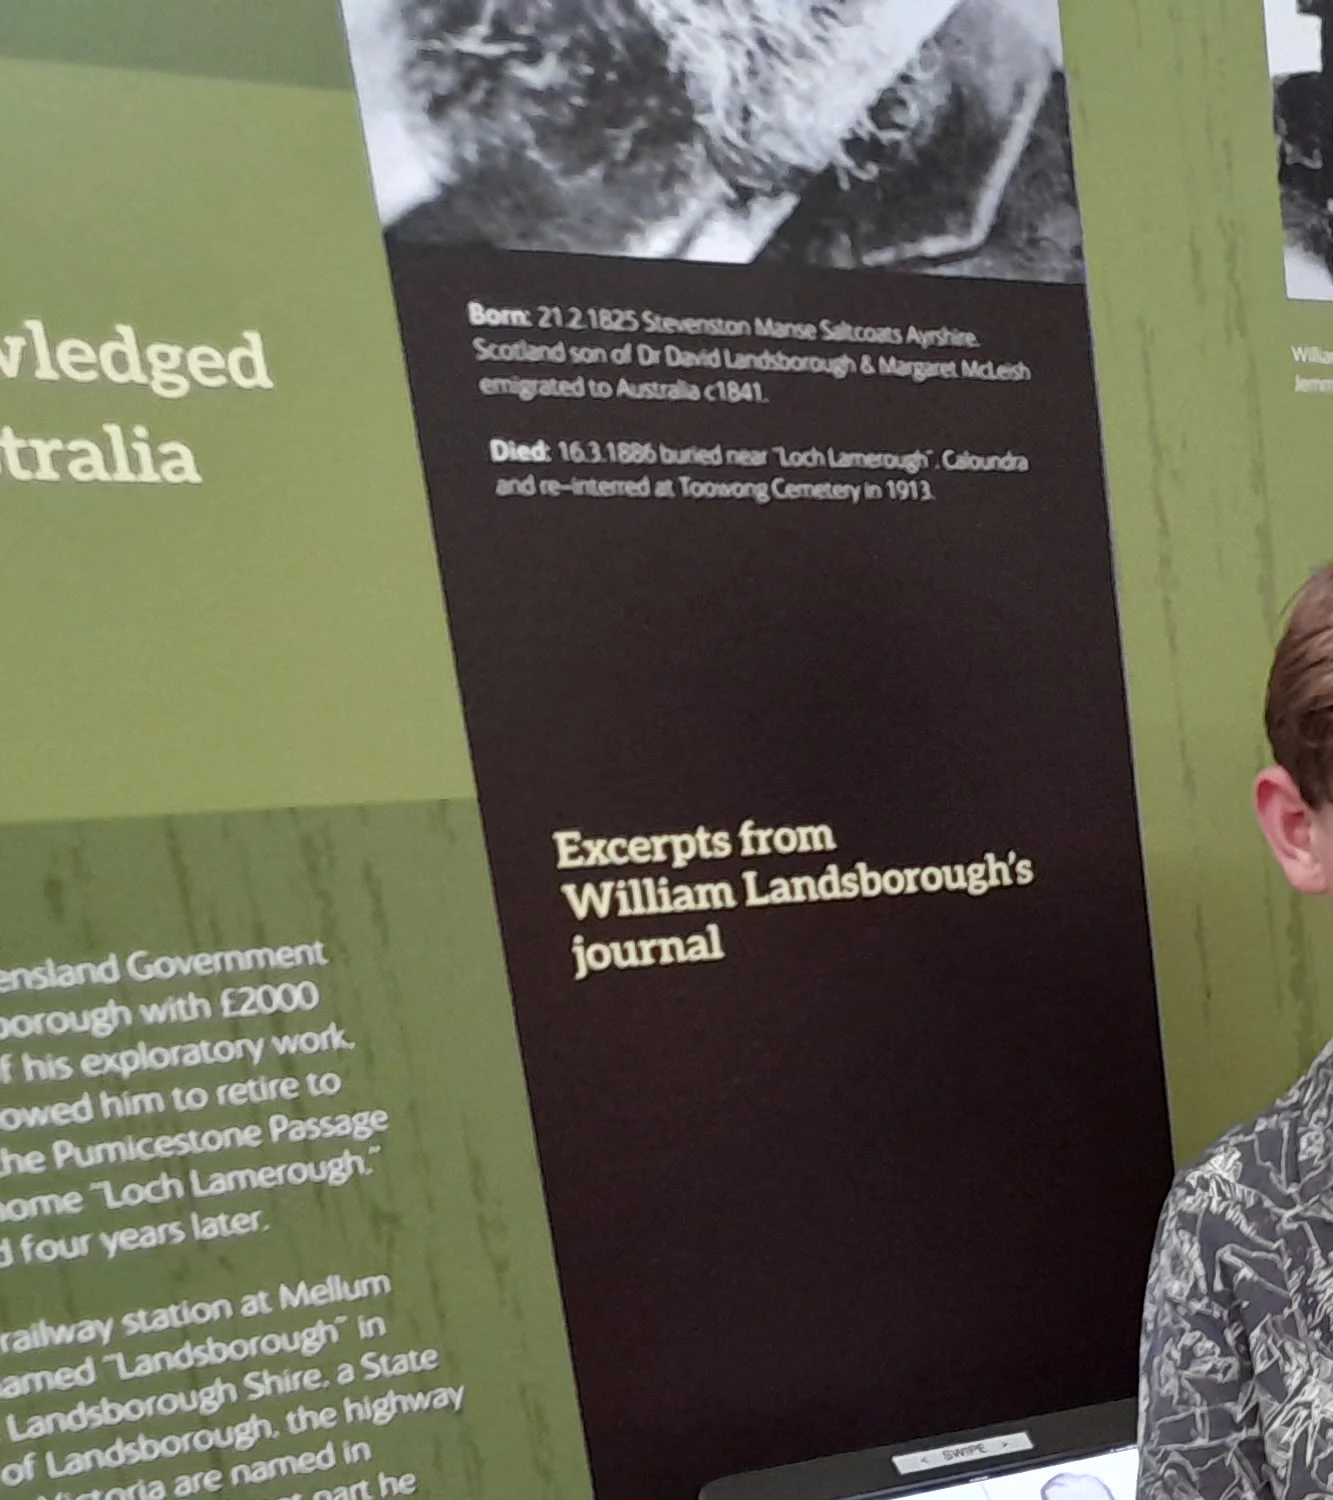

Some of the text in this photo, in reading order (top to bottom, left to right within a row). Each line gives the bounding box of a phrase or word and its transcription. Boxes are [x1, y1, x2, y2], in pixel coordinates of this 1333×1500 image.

[468, 302, 532, 327] Born:
[472, 338, 566, 363] Scotland
[569, 346, 607, 364] son
[610, 342, 632, 364] of
[637, 344, 660, 366] Dr
[664, 344, 721, 368] David
[724, 347, 857, 379] Landsborough
[860, 354, 876, 374] &
[879, 356, 958, 382] Margaret
[479, 376, 585, 400] emigrated
[588, 379, 613, 398] to
[617, 378, 700, 400] Australia
[490, 439, 552, 462] Died:
[659, 442, 722, 465] buried
[726, 450, 767, 465] near
[942, 450, 1029, 471] Caloundra
[496, 473, 536, 496] and
[539, 475, 650, 496] re-interred
[655, 480, 675, 497] at
[678, 476, 770, 504] Toowong
[771, 478, 861, 503] Cemetery
[864, 482, 883, 499] in
[553, 819, 836, 870] Excerpts from
[561, 851, 1035, 920] William Landsborough's
[126, 940, 329, 981] Government
[572, 923, 725, 980] journal
[139, 992, 212, 1023] with
[220, 981, 320, 1018] £2000
[21, 1022, 355, 1083] his exploratory work.
[0, 1072, 342, 1133] owed him to retire to
[52, 1123, 262, 1170] Pumicestone
[269, 1109, 390, 1142] Passage
[20, 1210, 270, 1263] four years later.
[0, 1273, 391, 1354] railway station at Mellum
[102, 1315, 348, 1381] "Landsborough"
[359, 1312, 387, 1340] in
[5, 1378, 237, 1443] Landsborough
[337, 1362, 355, 1385] a
[360, 1347, 440, 1380] State
[1, 1452, 36, 1488] of
[284, 1402, 338, 1435] the
[345, 1385, 465, 1426] highway
[942, 1443, 985, 1460] SWIPE
[174, 1466, 223, 1497] are
[230, 1441, 335, 1486] named
[344, 1439, 371, 1465] in
[379, 1471, 418, 1498] he
